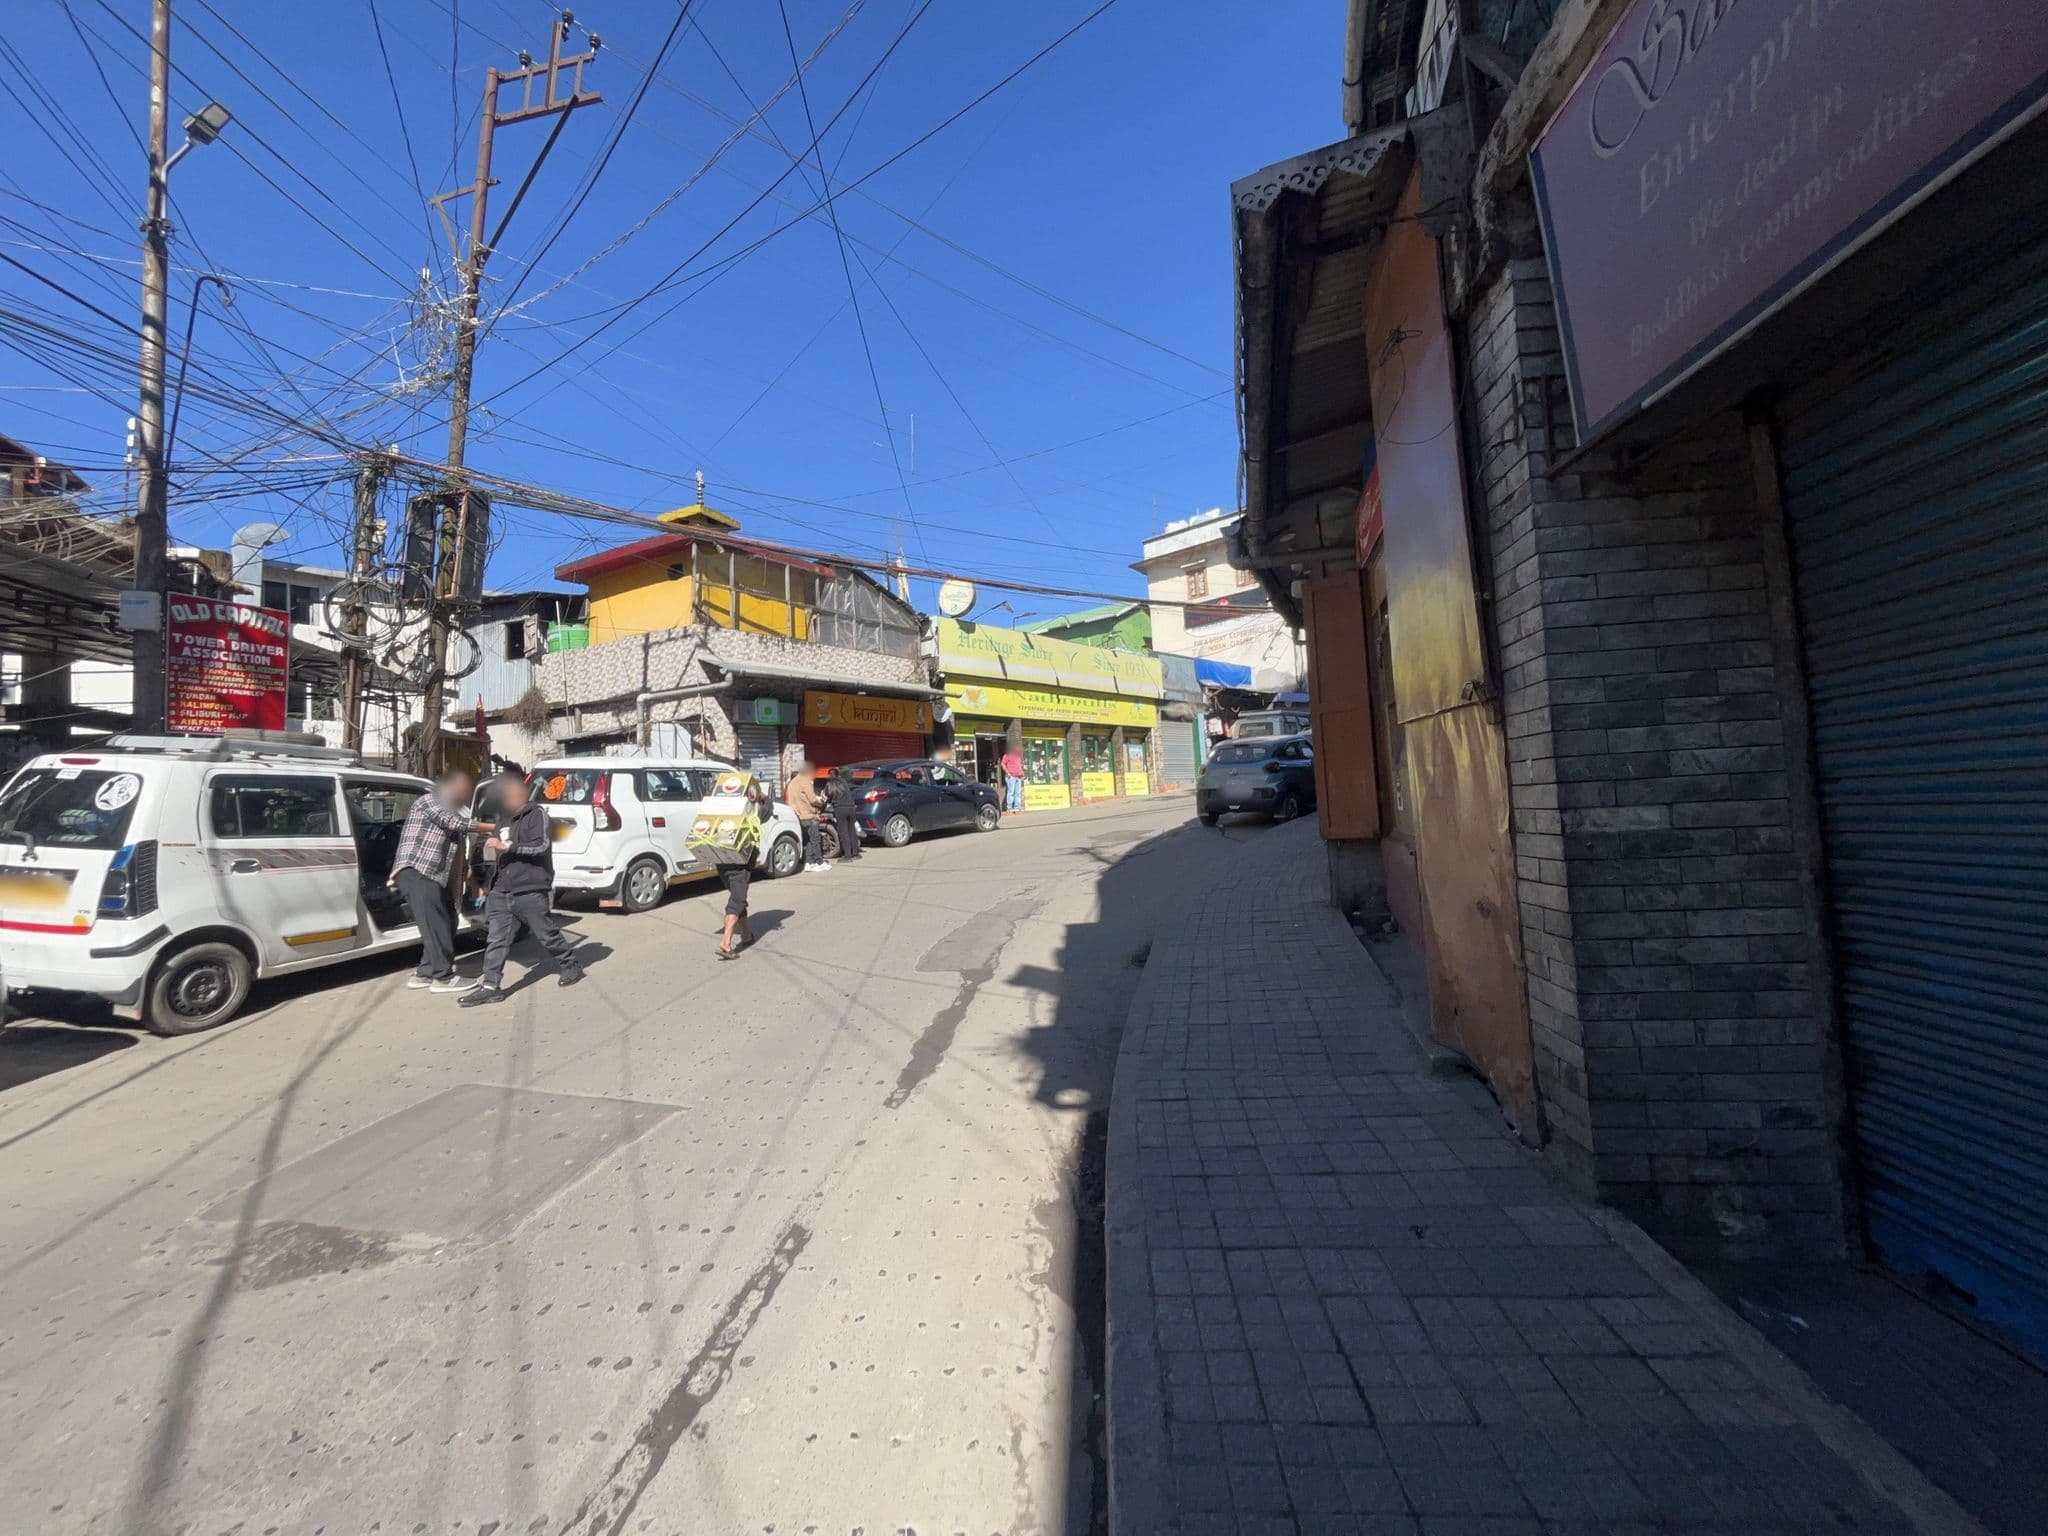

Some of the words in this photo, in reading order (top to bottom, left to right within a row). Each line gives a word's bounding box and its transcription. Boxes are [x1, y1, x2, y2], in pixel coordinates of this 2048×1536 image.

[1689, 198, 1724, 246] We
[1735, 113, 1798, 206] deal
[1810, 82, 1844, 136] in
[1740, 38, 1979, 265] commodities
[171, 603, 211, 623] OLD
[214, 604, 286, 638] CAPITAL
[172, 632, 225, 649] TOWER
[231, 640, 284, 656] DRIVER
[181, 646, 271, 665] ASSOCIATION
[957, 631, 1014, 657] Heritage
[1022, 642, 1053, 661] Store
[1094, 656, 1121, 673] Since
